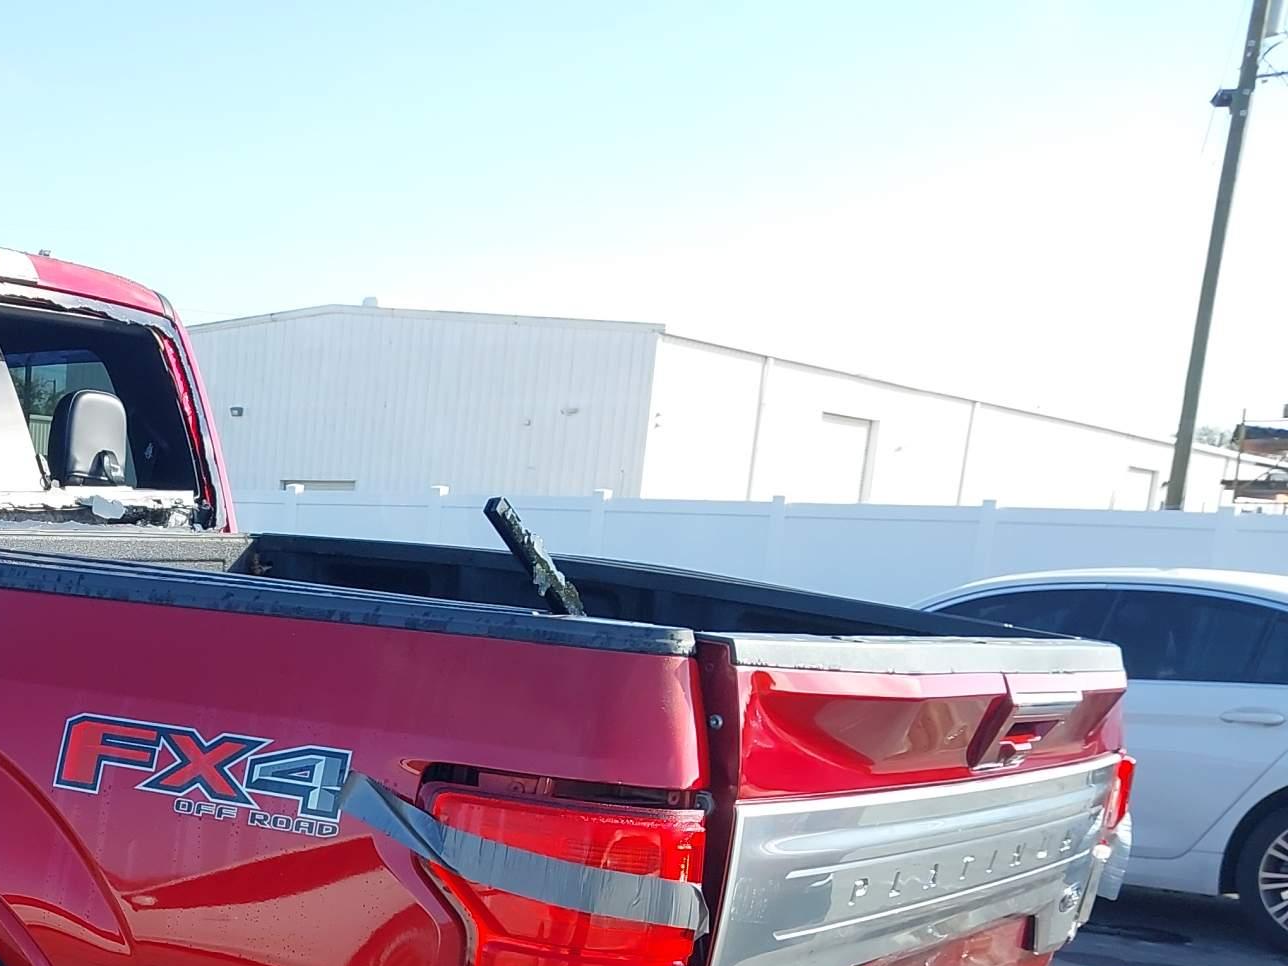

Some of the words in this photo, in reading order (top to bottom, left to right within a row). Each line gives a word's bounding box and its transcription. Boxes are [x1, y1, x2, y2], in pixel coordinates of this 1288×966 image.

[53, 712, 352, 822] FX4
[174, 797, 237, 820] OFF
[248, 809, 340, 837] ROAD
